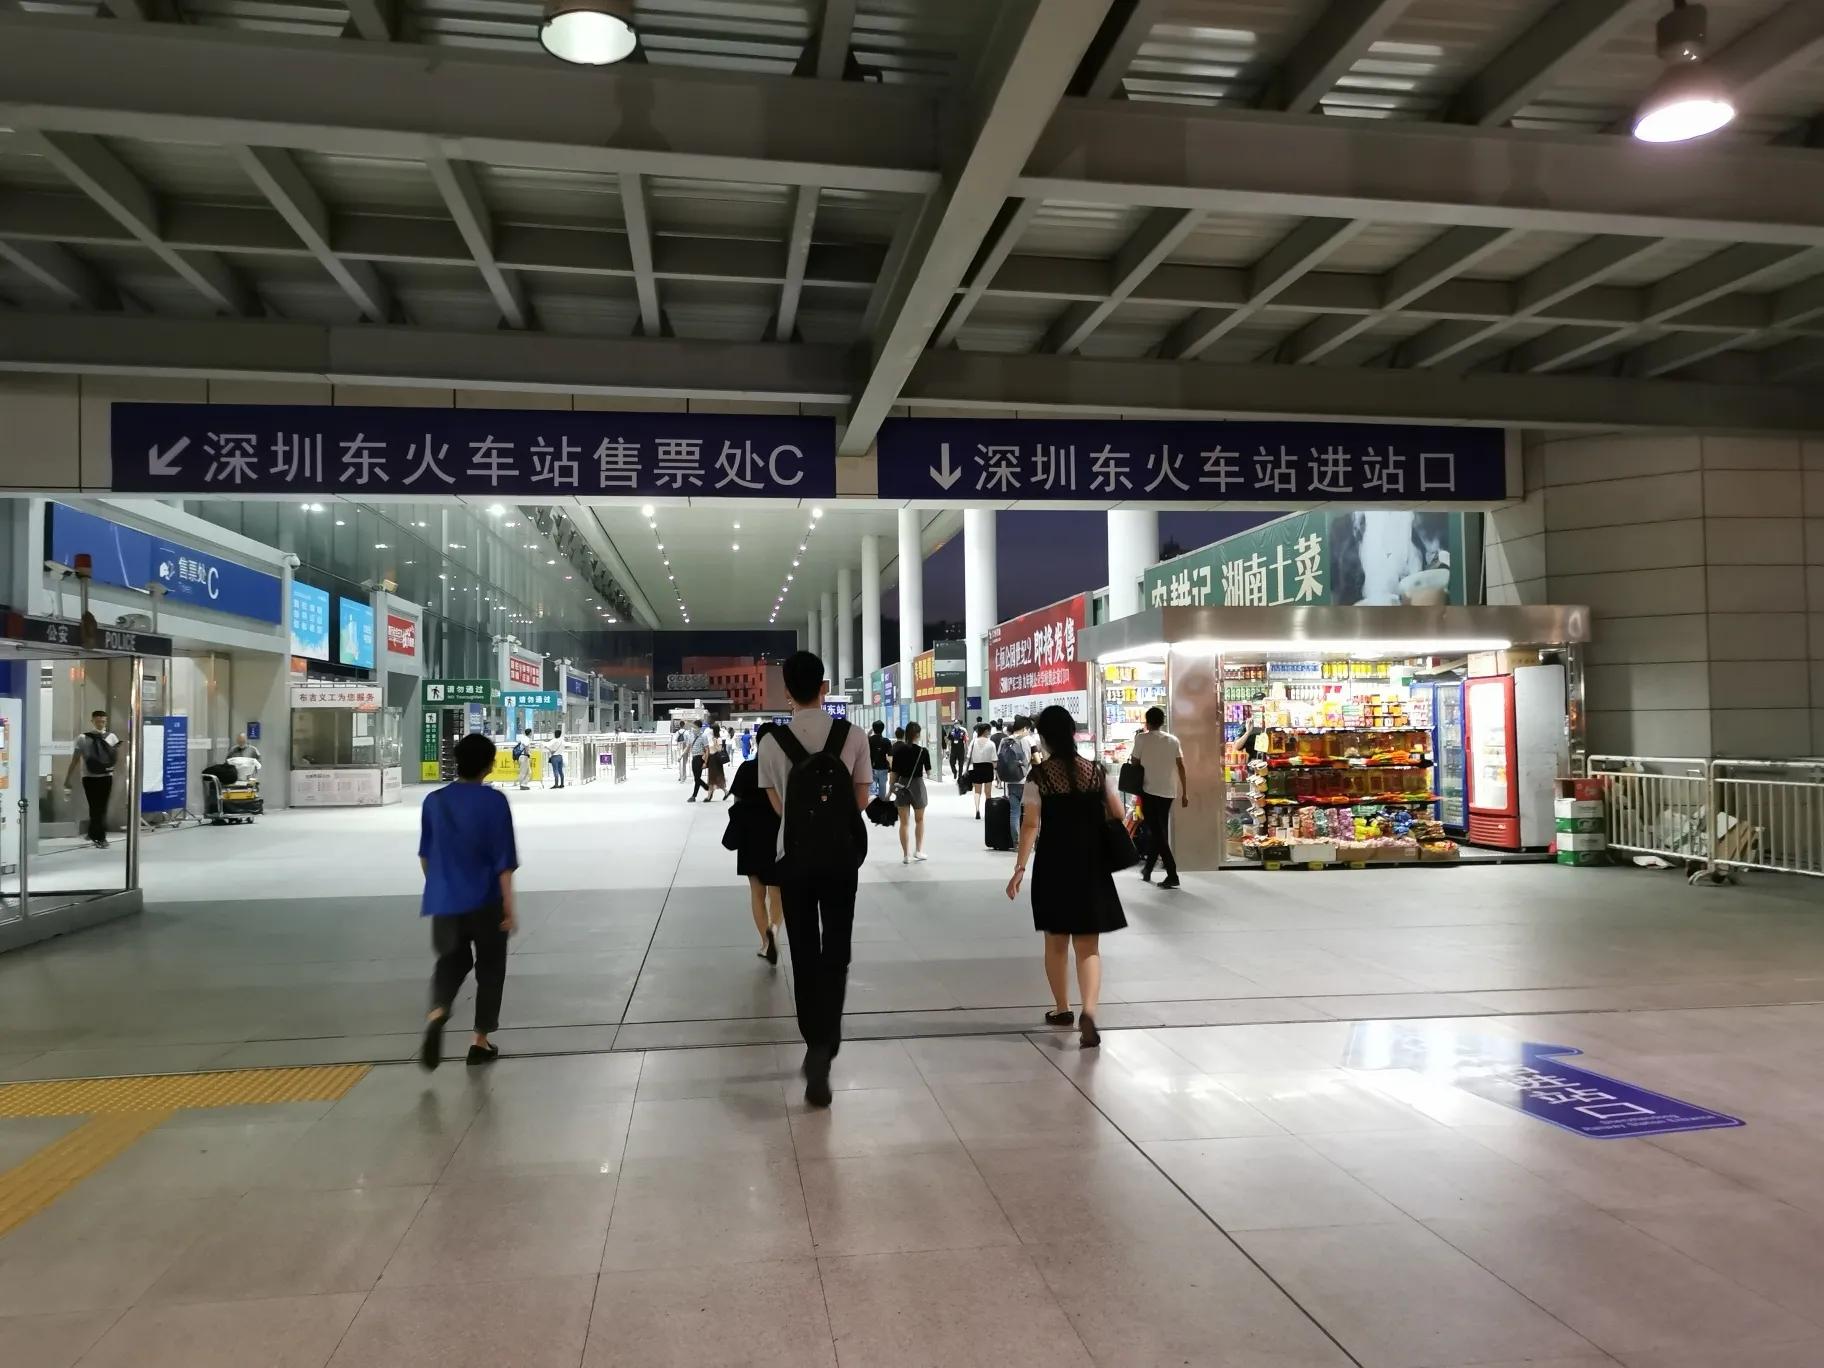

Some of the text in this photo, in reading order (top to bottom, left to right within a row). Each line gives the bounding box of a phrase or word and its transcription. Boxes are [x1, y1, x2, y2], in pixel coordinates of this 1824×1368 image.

[202, 430, 806, 489] 深圳东火车站售票处C
[974, 442, 1457, 494] 深圳东火车站进站口
[1221, 532, 1324, 607] 湖南土菜
[46, 623, 70, 644] 公安
[105, 631, 137, 651] POLICE
[1033, 616, 1076, 667] 即将发售
[299, 692, 375, 703] 布吉义工为您服务
[447, 685, 484, 695] 请勿通过
[518, 695, 551, 704] 请勿通过
